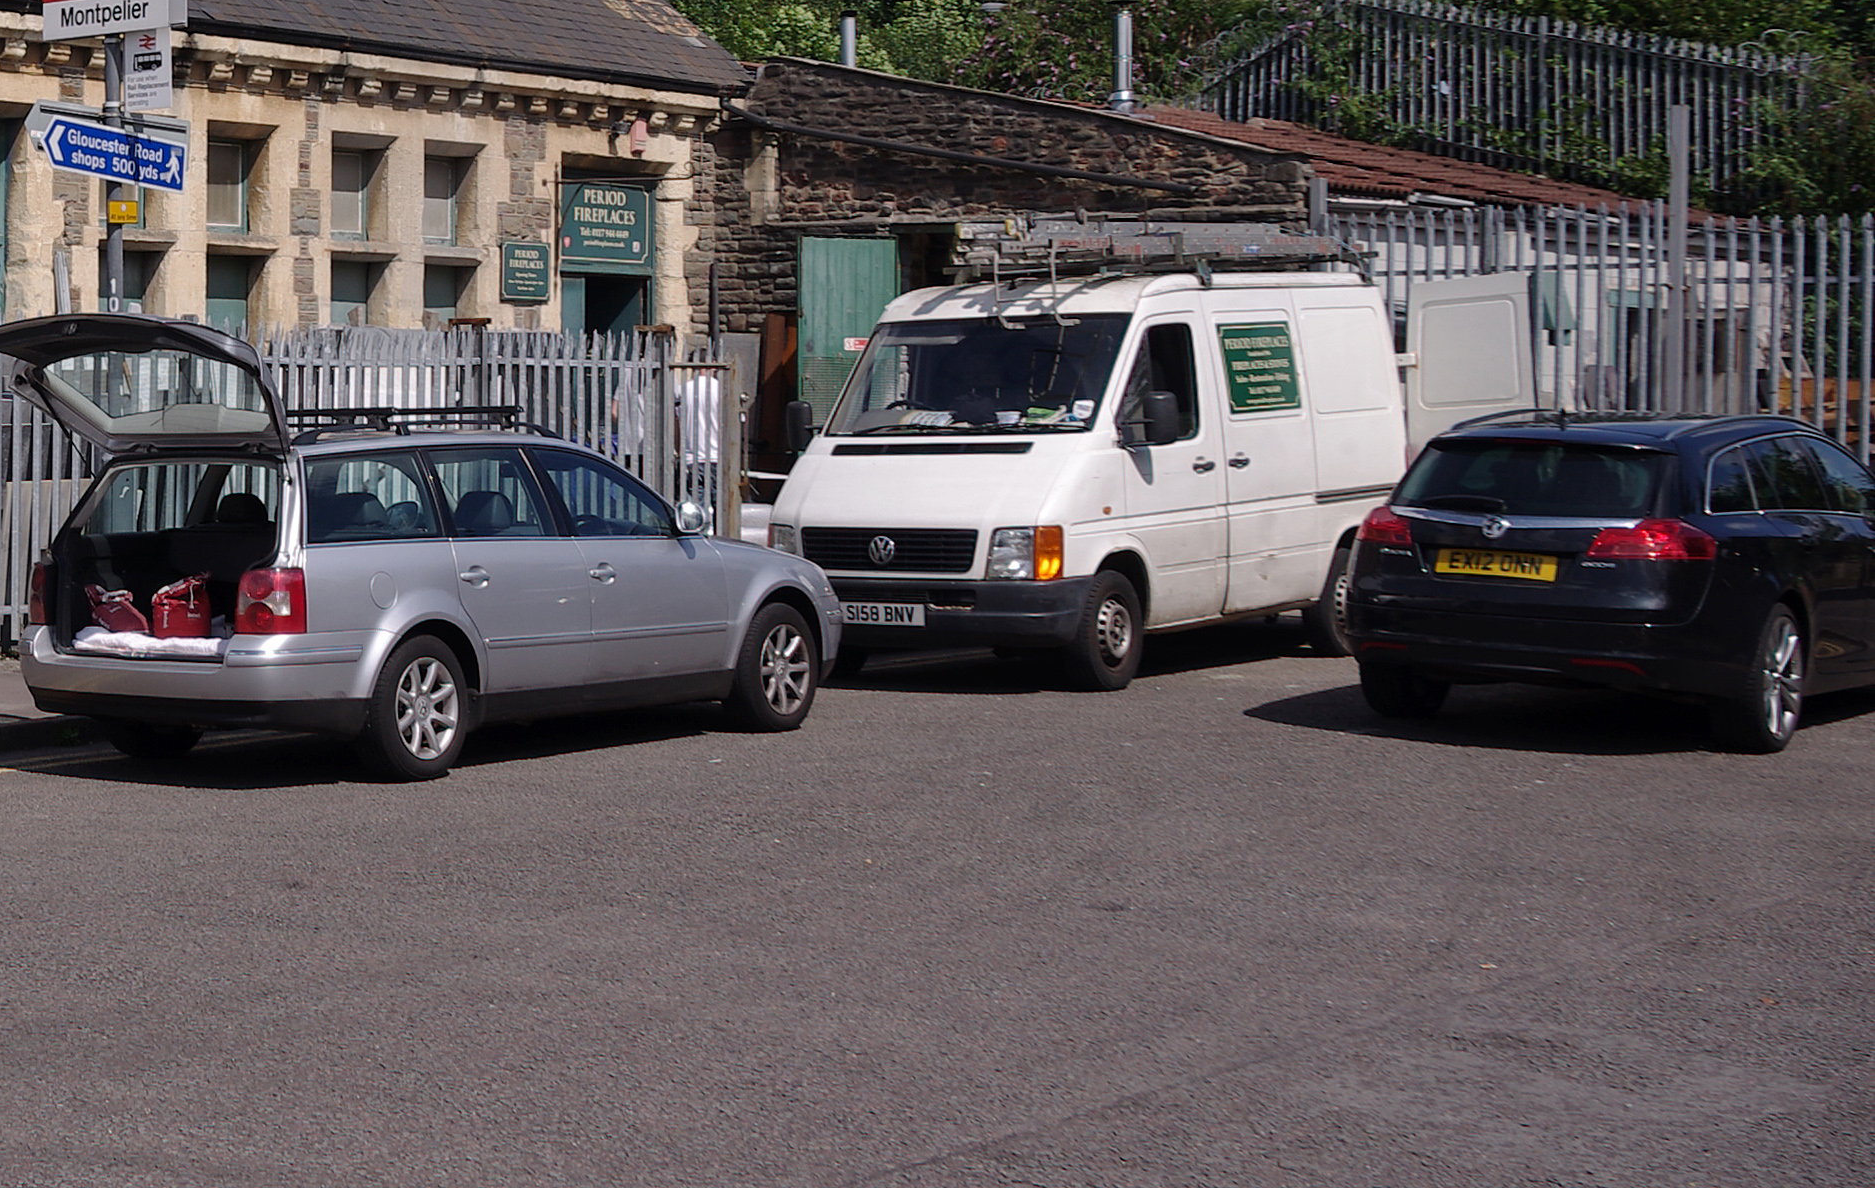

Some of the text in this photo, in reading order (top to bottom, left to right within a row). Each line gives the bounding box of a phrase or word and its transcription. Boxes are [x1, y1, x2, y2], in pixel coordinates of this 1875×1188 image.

[61, 0, 149, 28] Montpelier
[137, 82, 170, 90] Replacement
[67, 129, 163, 162] Gloucester Road
[71, 149, 159, 180] shops 500 yds
[584, 189, 627, 206] PERIOD
[574, 206, 636, 225] FIREPLACES
[509, 258, 544, 269] FIREPLACES
[514, 249, 540, 259] PERIOD
[1448, 551, 1544, 576] EX12 ONN
[846, 604, 915, 623] S158 BNV
